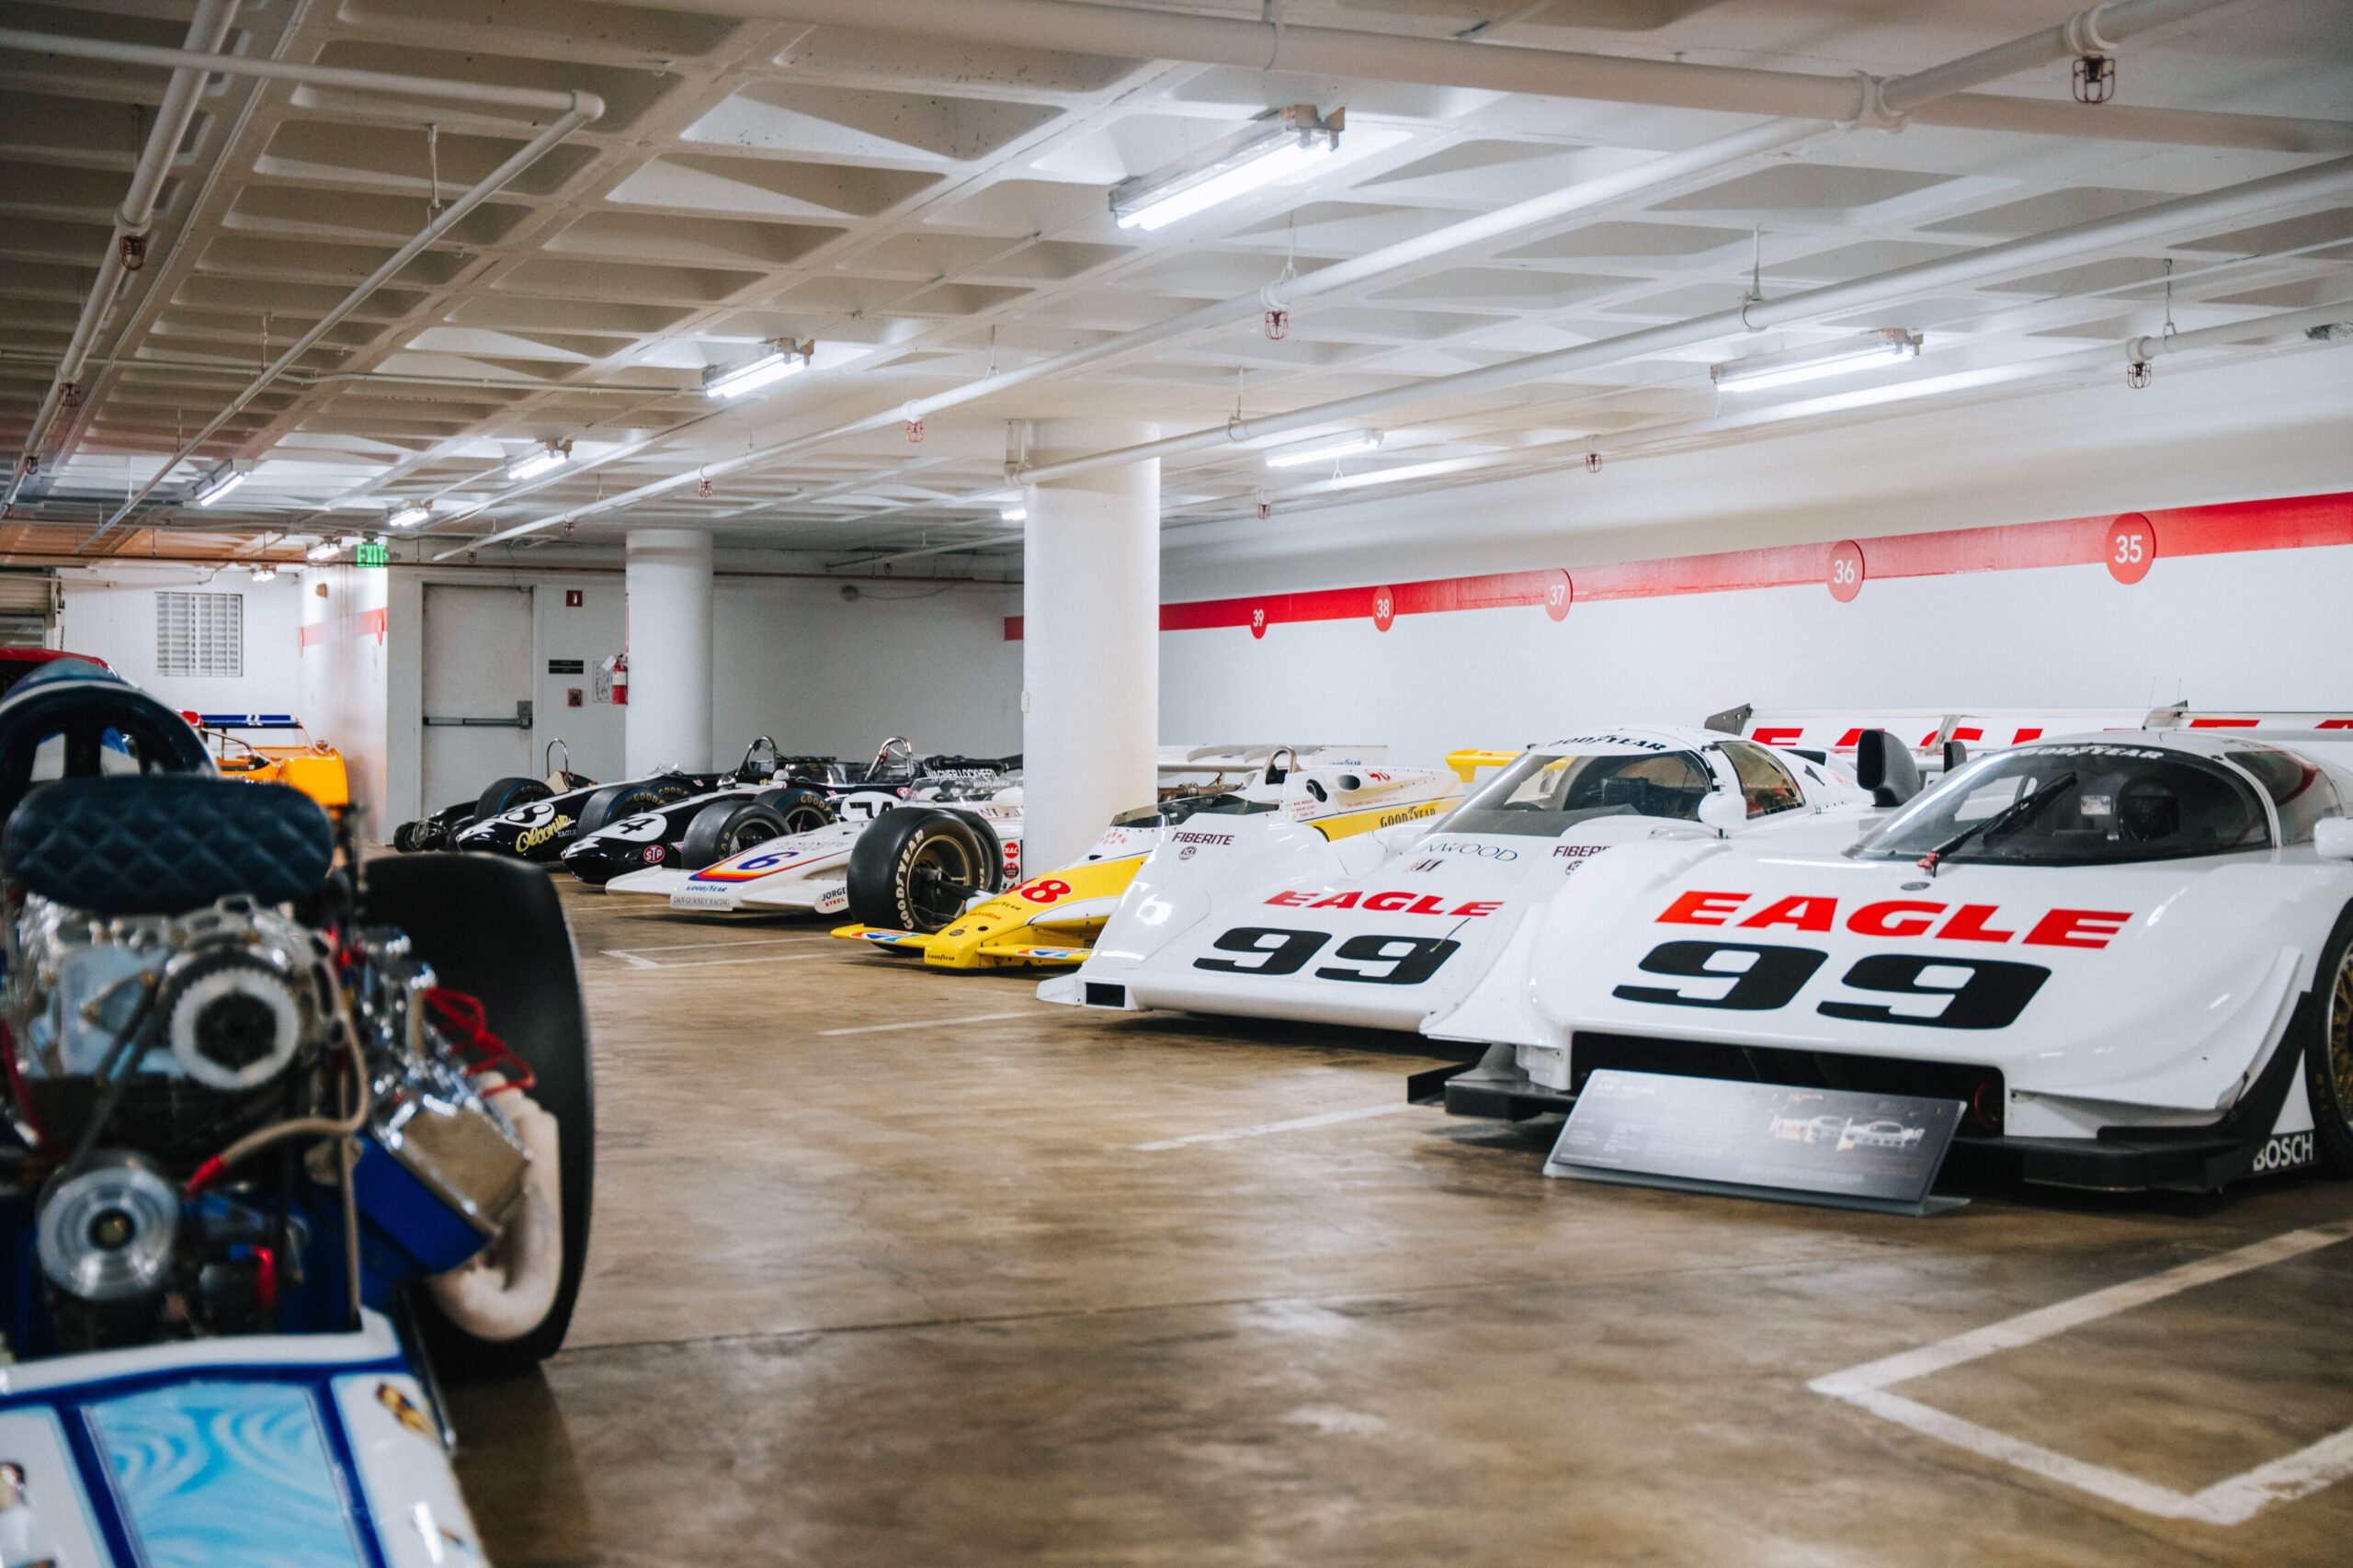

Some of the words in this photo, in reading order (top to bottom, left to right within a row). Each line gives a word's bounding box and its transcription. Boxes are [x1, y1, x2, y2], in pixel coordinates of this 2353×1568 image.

[358, 545, 385, 566] EXIT
[2115, 534, 2143, 563] 35
[1834, 559, 1855, 585] 36
[1550, 585, 1564, 606] 37
[1253, 608, 1264, 628] 39
[1377, 598, 1389, 619] 38
[619, 817, 657, 835] 4
[1380, 806, 1437, 828] GOODYEAR
[558, 829, 577, 838] EAGLE
[1172, 832, 1235, 846] FIBERITE
[644, 846, 664, 861] STP
[737, 851, 799, 870] 6
[1553, 846, 1614, 857] FIBER
[895, 829, 925, 930] GOODYEAR
[673, 896, 686, 904] DAN
[686, 897, 709, 905] GURNEY
[710, 898, 730, 906] RACING
[822, 886, 847, 902] JORGE
[824, 897, 846, 907] STEEL
[1263, 890, 1505, 917] EAGLE
[1654, 890, 2134, 949] EAGLE
[1192, 926, 1461, 985] 99
[1611, 940, 2052, 1030] 99
[2253, 1132, 2313, 1173] BOSCH
